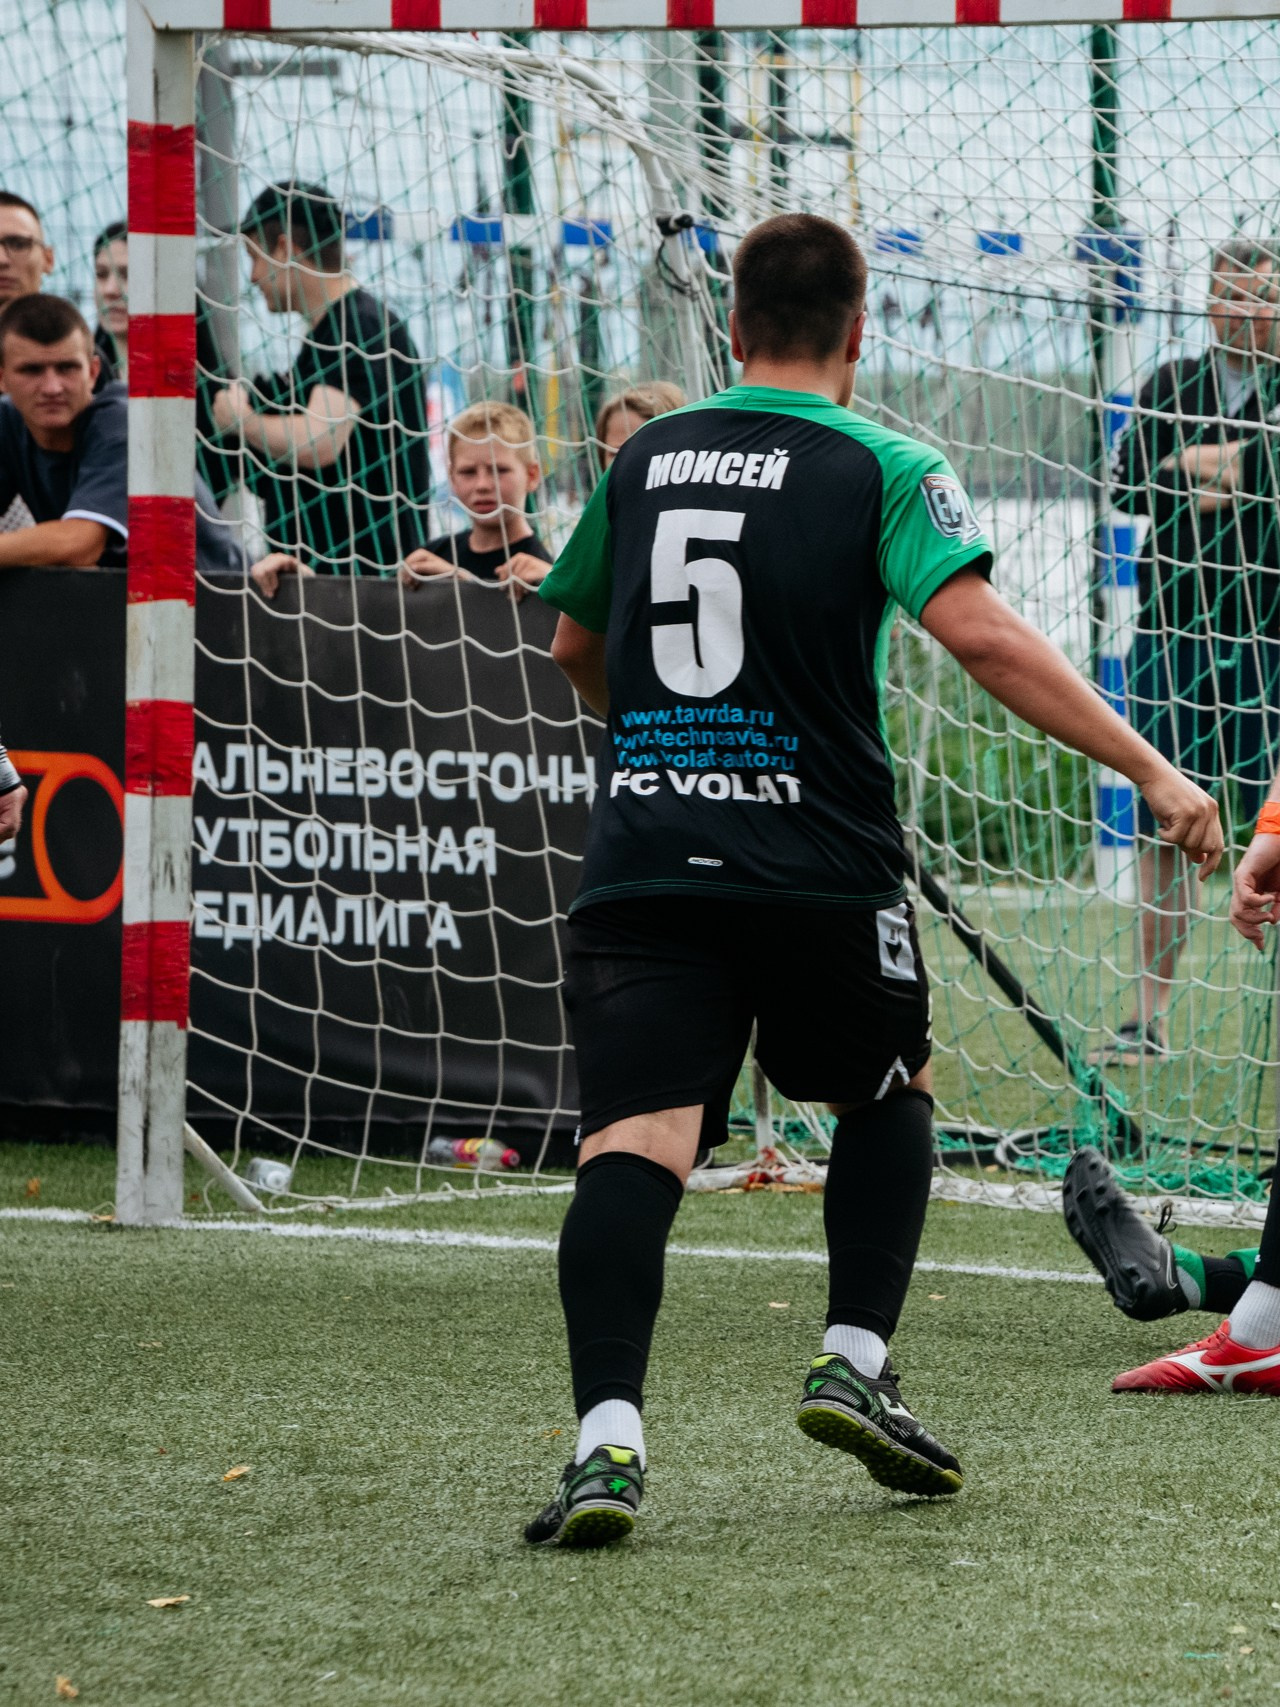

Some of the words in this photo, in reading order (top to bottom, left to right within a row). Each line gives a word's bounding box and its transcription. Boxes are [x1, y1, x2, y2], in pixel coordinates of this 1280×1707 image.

[645, 448, 790, 490] МОИСЕЙ
[650, 508, 746, 698] 5
[193, 741, 596, 804] АЛЬНЕВОСТОЧН
[610, 768, 660, 798] FC
[666, 769, 801, 804] VOLAT
[194, 816, 497, 877] УТБОЛЬНАЯ
[194, 890, 463, 950] ЕДИАЛИГА
